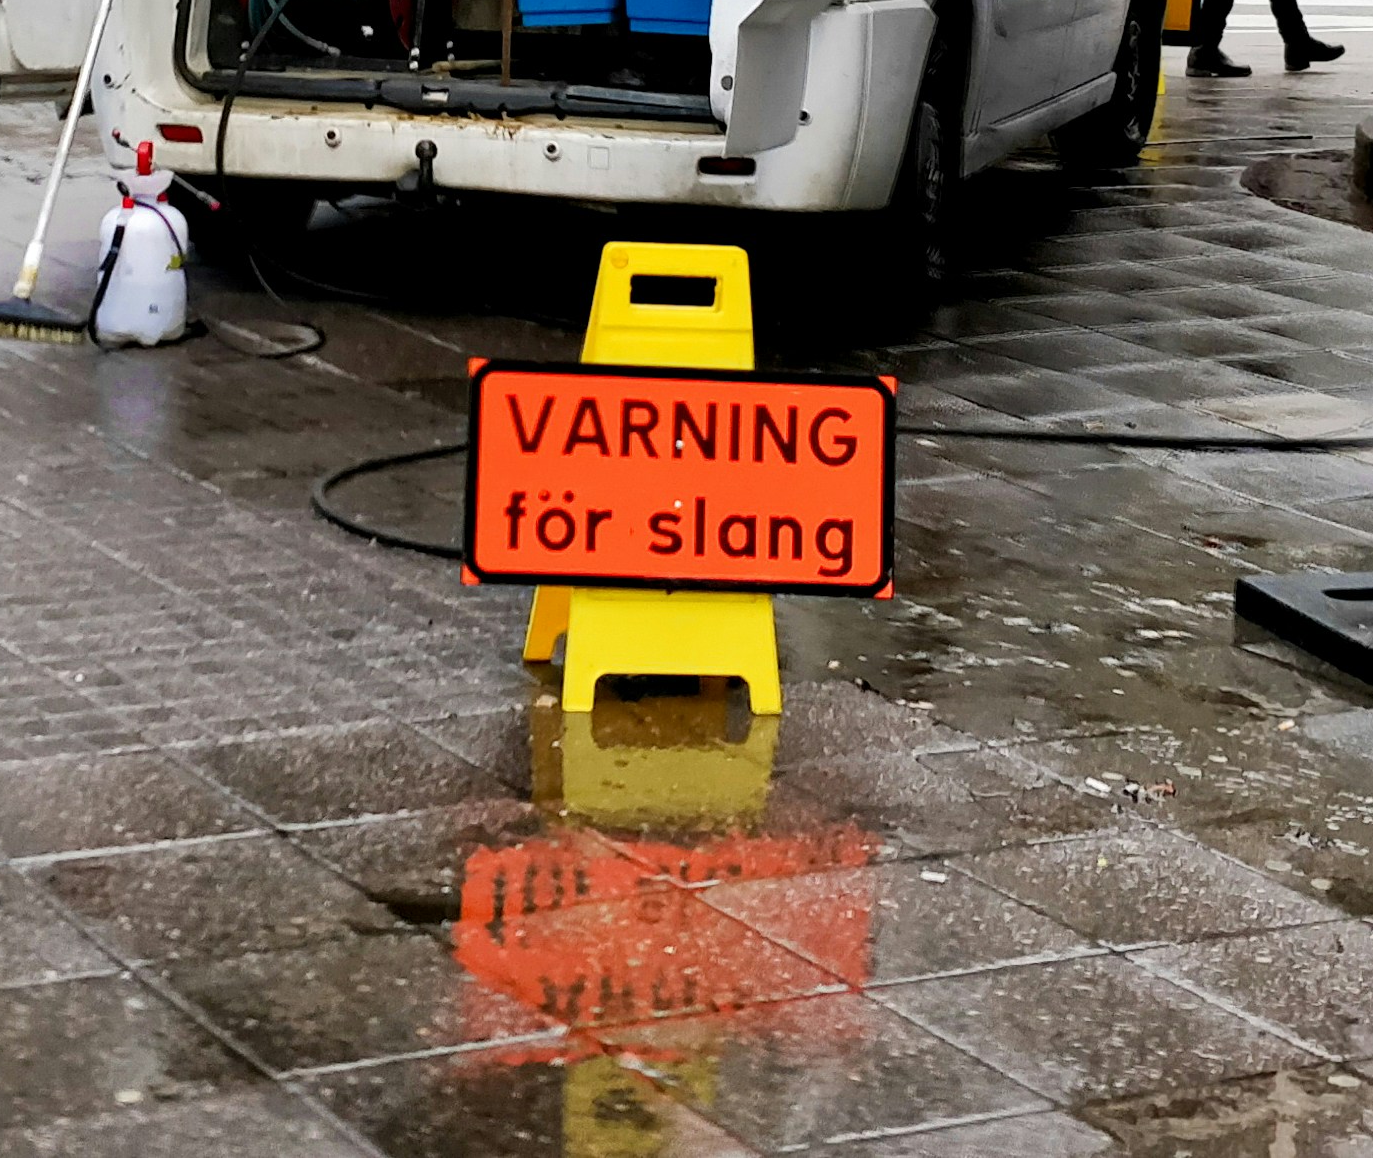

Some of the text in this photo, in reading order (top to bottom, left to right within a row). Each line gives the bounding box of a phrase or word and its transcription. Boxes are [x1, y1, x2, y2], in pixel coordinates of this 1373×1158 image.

[505, 394, 857, 466] VARNING
[504, 490, 854, 577] för slang
